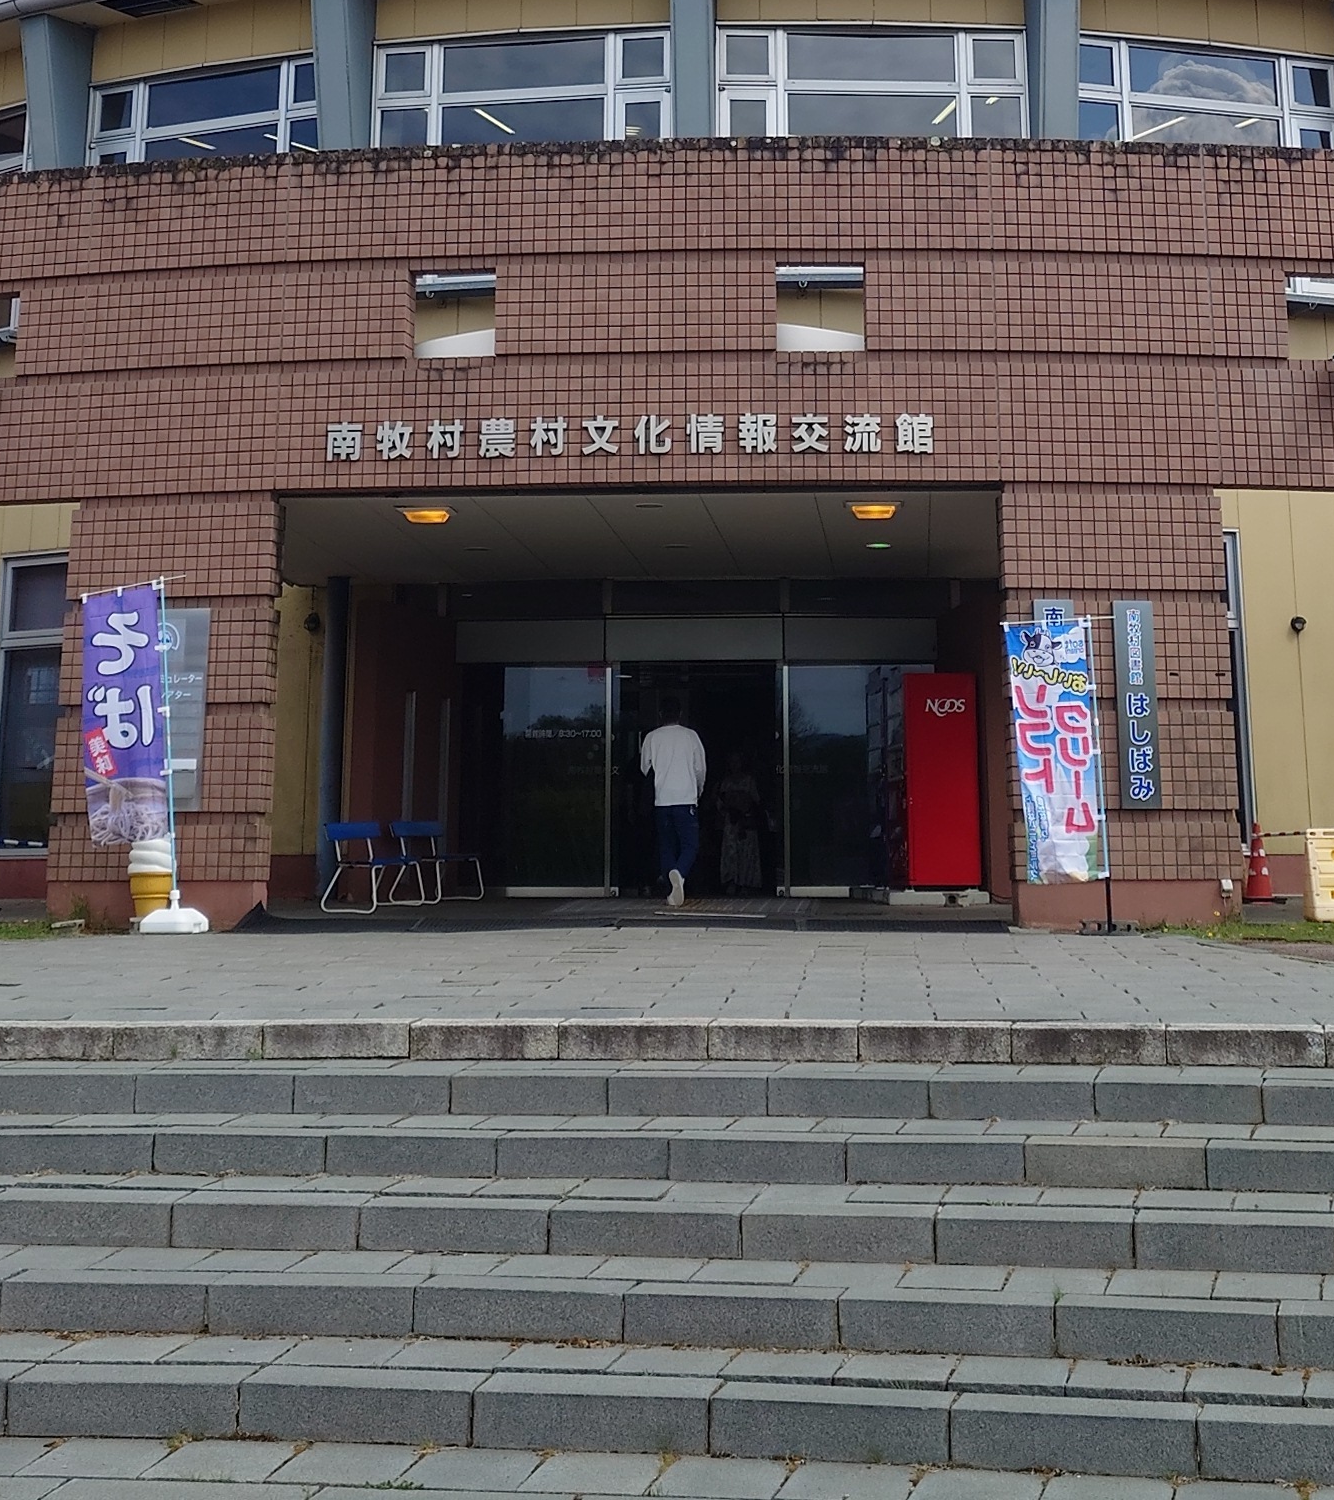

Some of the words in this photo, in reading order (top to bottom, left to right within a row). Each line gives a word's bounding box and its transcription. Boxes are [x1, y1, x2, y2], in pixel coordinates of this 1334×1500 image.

[326, 413, 934, 462] 南牧村農村文化情報交流館
[1126, 609, 1143, 685] 南牧村図書館
[1126, 692, 1154, 801] はしばみ
